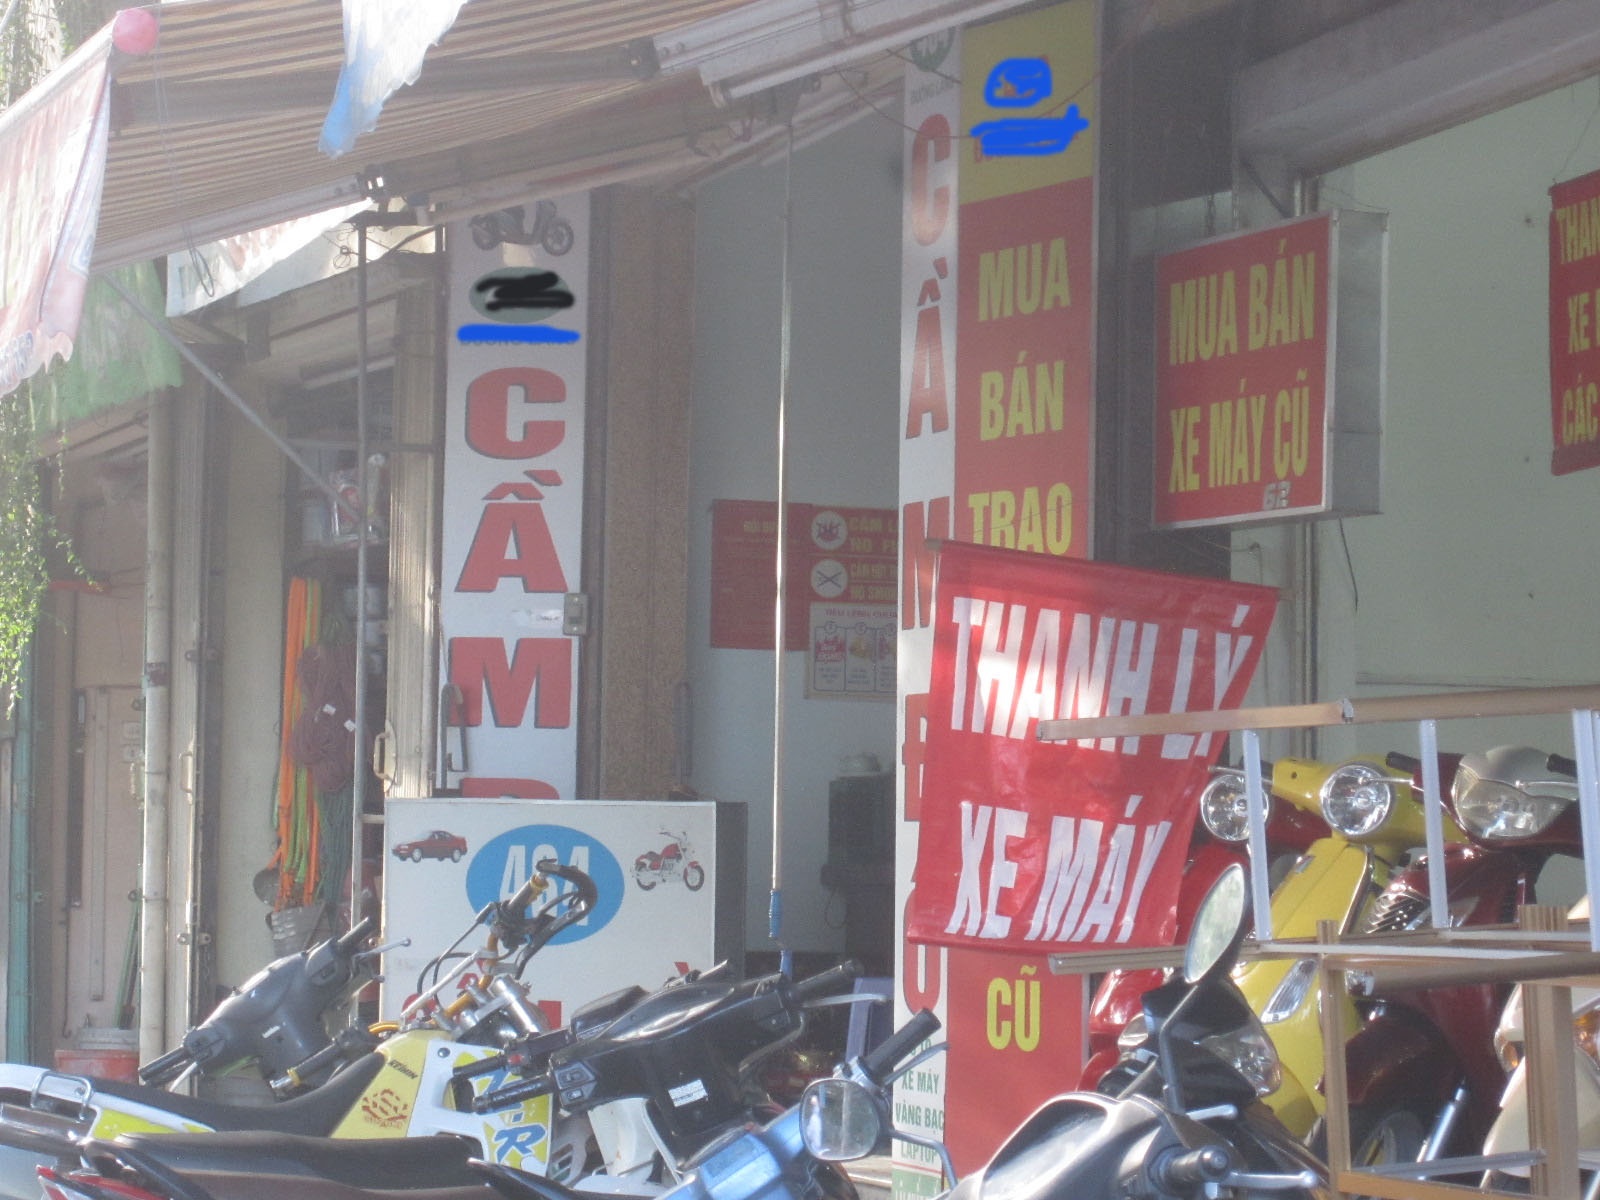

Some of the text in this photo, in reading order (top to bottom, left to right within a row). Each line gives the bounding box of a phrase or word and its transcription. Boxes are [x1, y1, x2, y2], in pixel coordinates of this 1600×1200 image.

[978, 238, 1071, 322] MUA
[1169, 239, 1315, 366] MUA BÁN
[1568, 292, 1590, 354] XE
[980, 352, 1065, 441] BÁN
[1168, 369, 1309, 493] XE MÁY CŨ
[1562, 372, 1598, 445] CÁC
[448, 366, 572, 728] CẦM
[968, 483, 1073, 555] TRAO
[951, 596, 1253, 760] THANH LÝ
[945, 795, 1172, 943] XE MÁY
[987, 965, 1041, 1052] CŨ
[895, 1100, 945, 1134] VÀNG BẠC
[902, 1068, 939, 1095] XE MÁY
